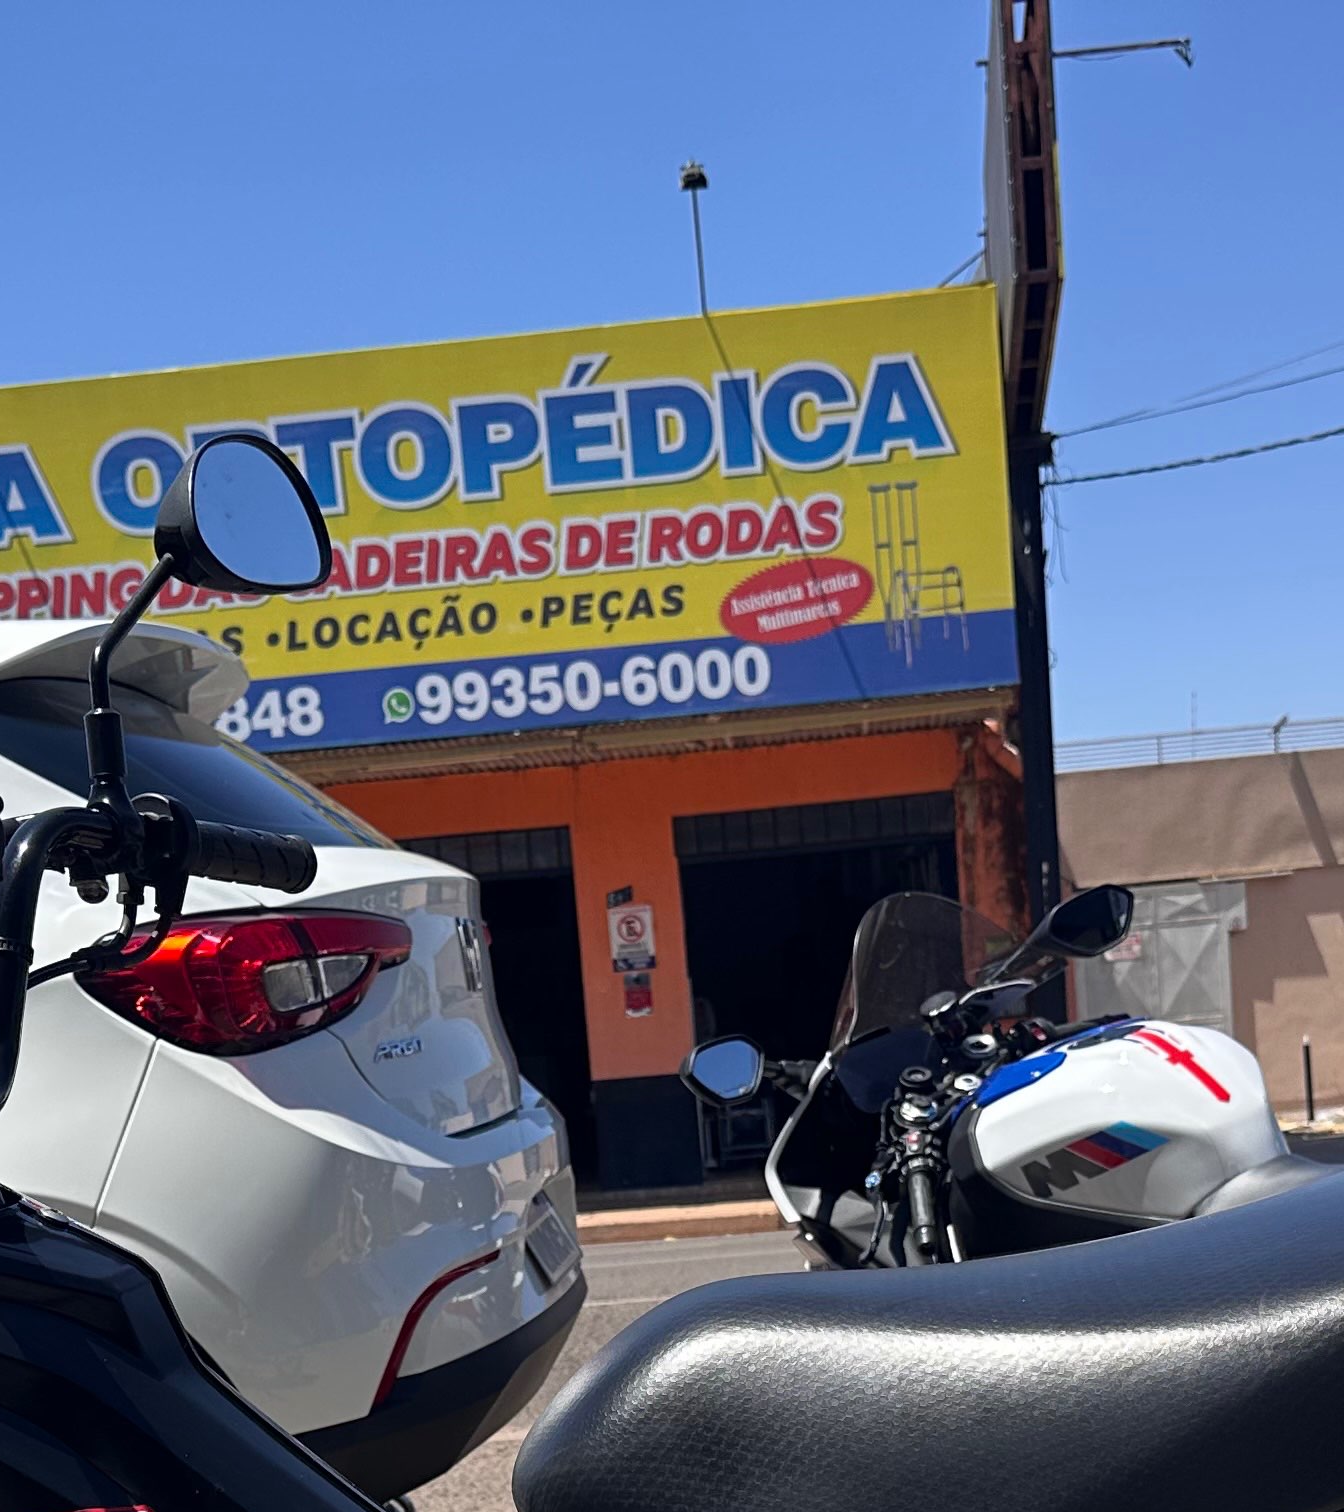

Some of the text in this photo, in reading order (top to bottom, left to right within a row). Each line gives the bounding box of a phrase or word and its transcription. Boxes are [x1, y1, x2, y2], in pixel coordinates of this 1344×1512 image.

[92, 351, 957, 538] OTOPÉDICA
[286, 520, 557, 602] ADEIRAS
[559, 512, 639, 574] DE
[643, 493, 844, 566] RODAS
[416, 643, 771, 726] 99350-6000
